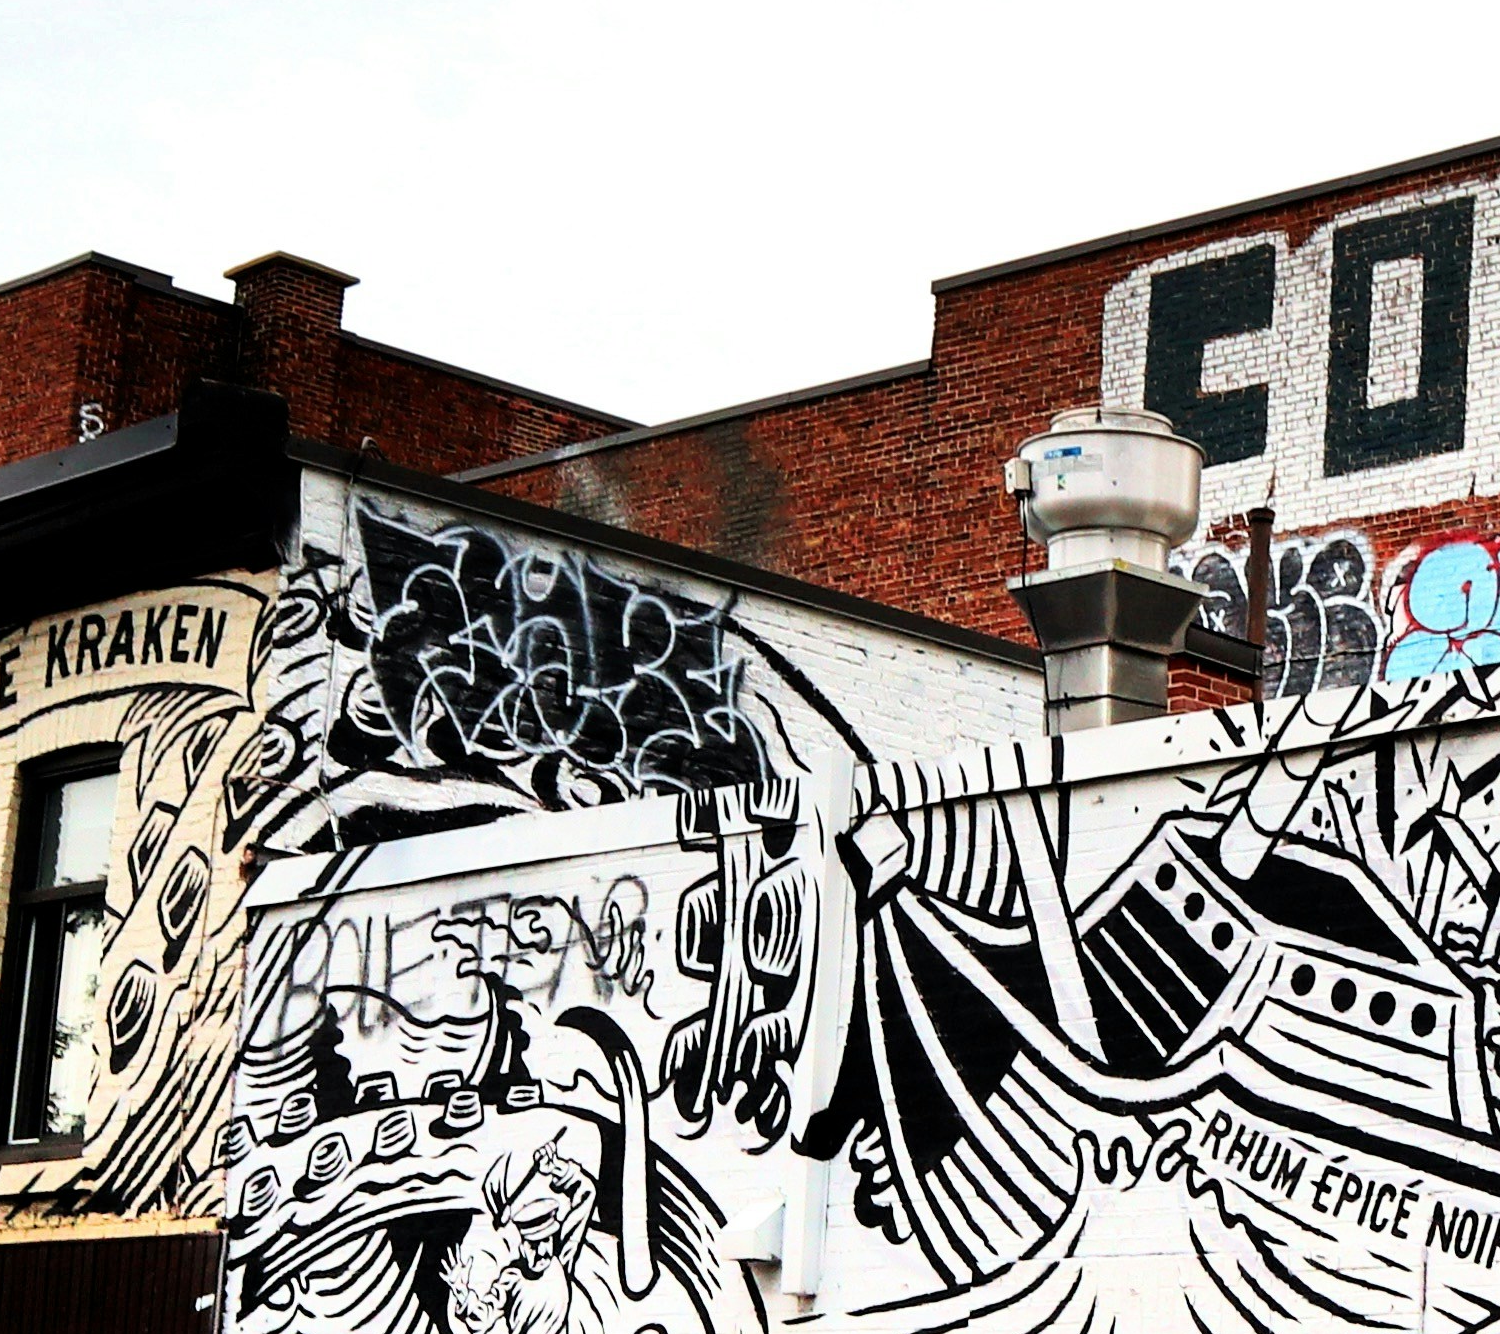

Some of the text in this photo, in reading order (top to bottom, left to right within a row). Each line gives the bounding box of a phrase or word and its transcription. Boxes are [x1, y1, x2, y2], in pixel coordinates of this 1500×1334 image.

[45, 603, 227, 680] KRAKEN
[1200, 1109, 1308, 1198] RHUM
[1311, 1156, 1420, 1239] ÉPICÉ
